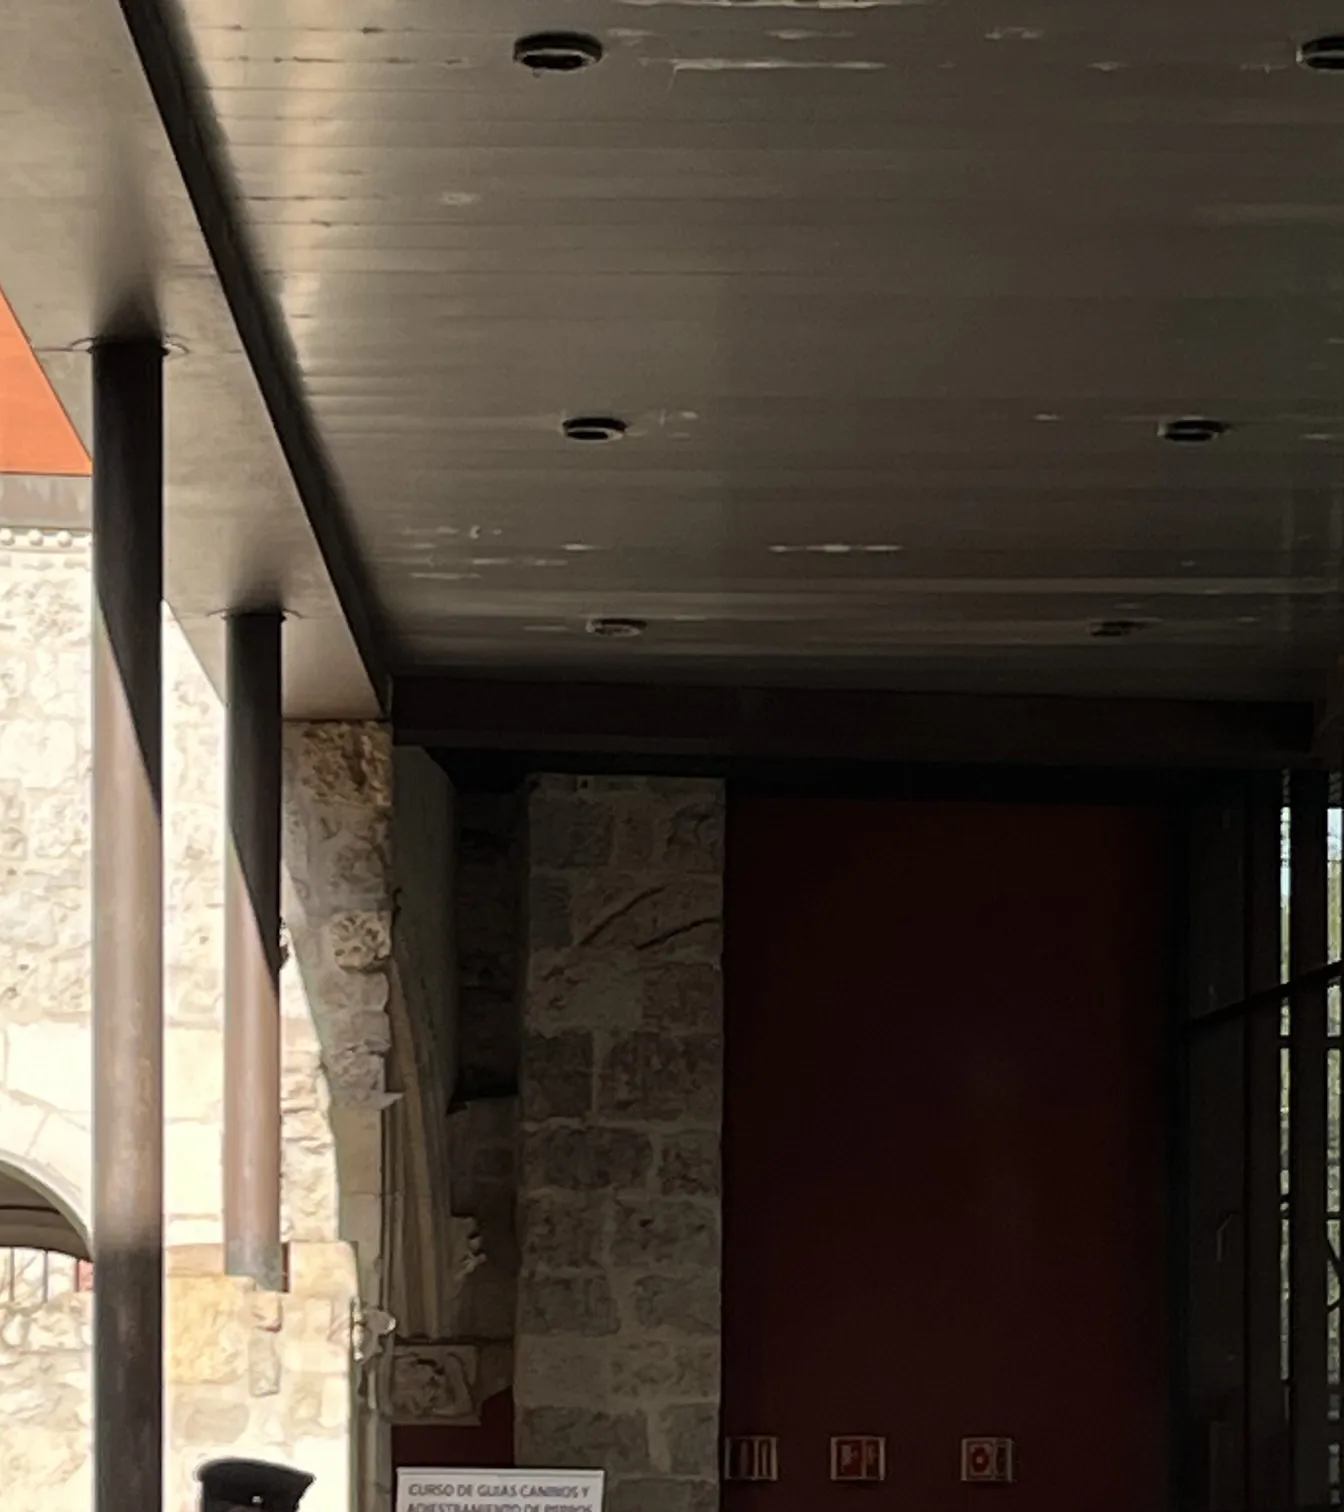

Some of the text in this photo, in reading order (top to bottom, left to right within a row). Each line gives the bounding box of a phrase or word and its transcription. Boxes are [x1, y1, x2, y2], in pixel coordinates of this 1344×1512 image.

[408, 1484, 454, 1497] CURSO
[457, 1484, 473, 1497] DE
[581, 1486, 590, 1498] Y
